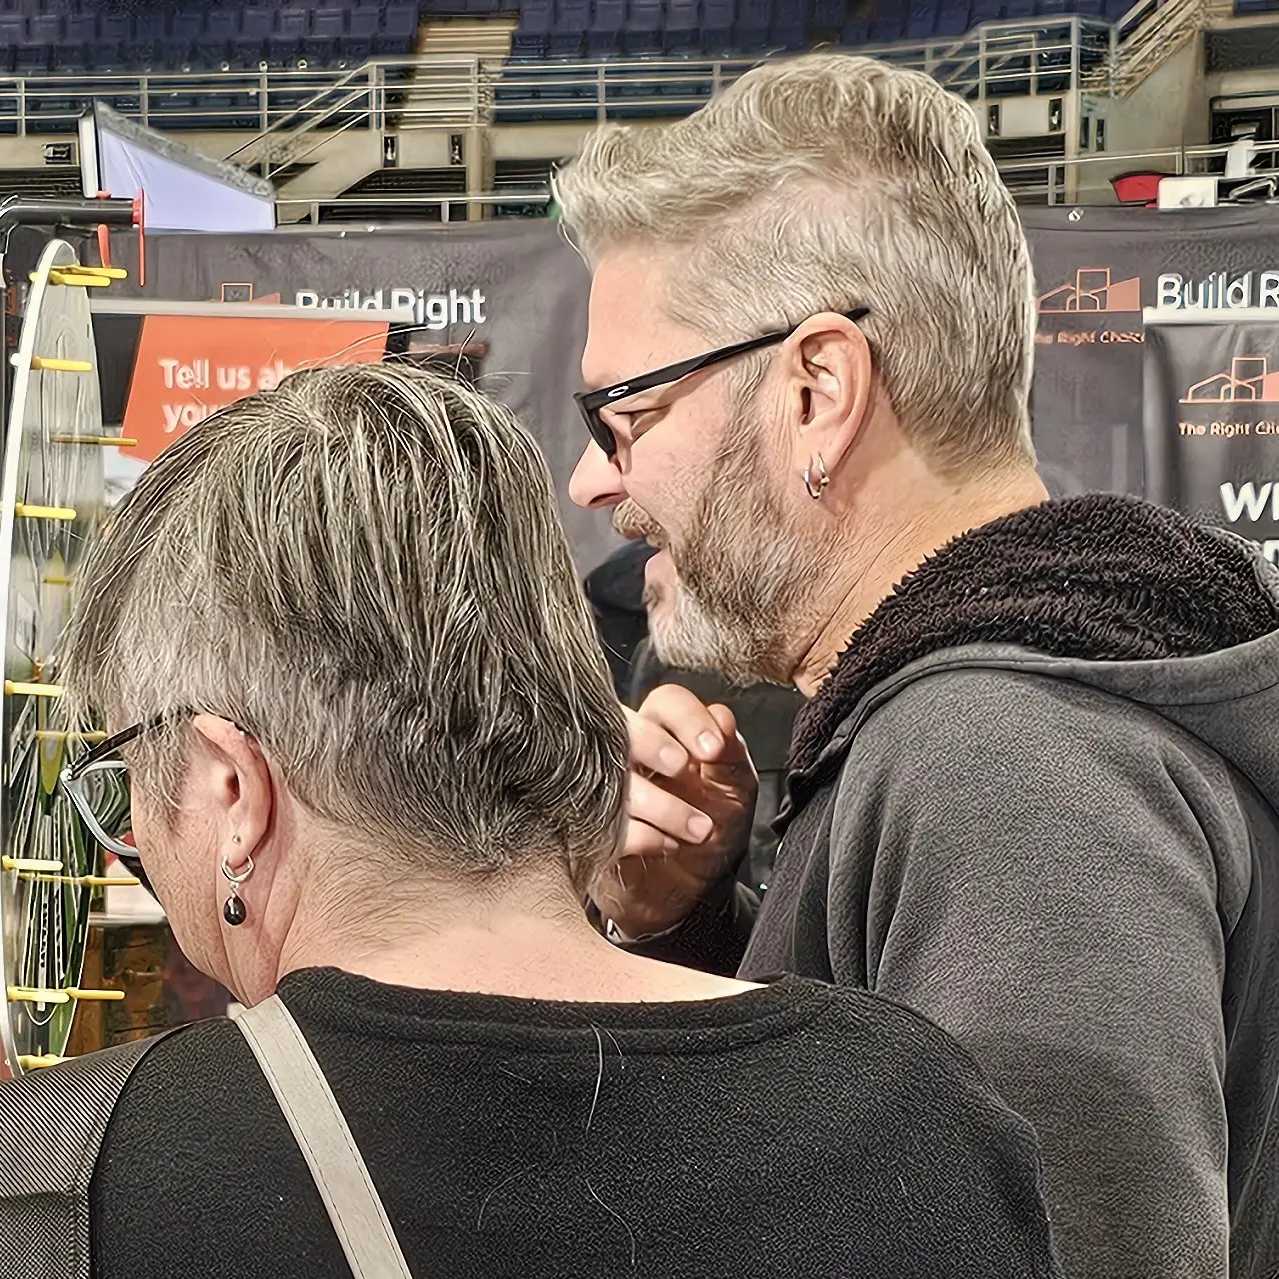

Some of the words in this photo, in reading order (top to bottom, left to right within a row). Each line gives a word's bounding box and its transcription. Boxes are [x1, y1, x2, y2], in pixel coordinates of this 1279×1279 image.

[156, 357, 211, 390] Tell
[216, 365, 252, 391] us
[1178, 421, 1207, 436] The
[1210, 421, 1251, 438] Right
